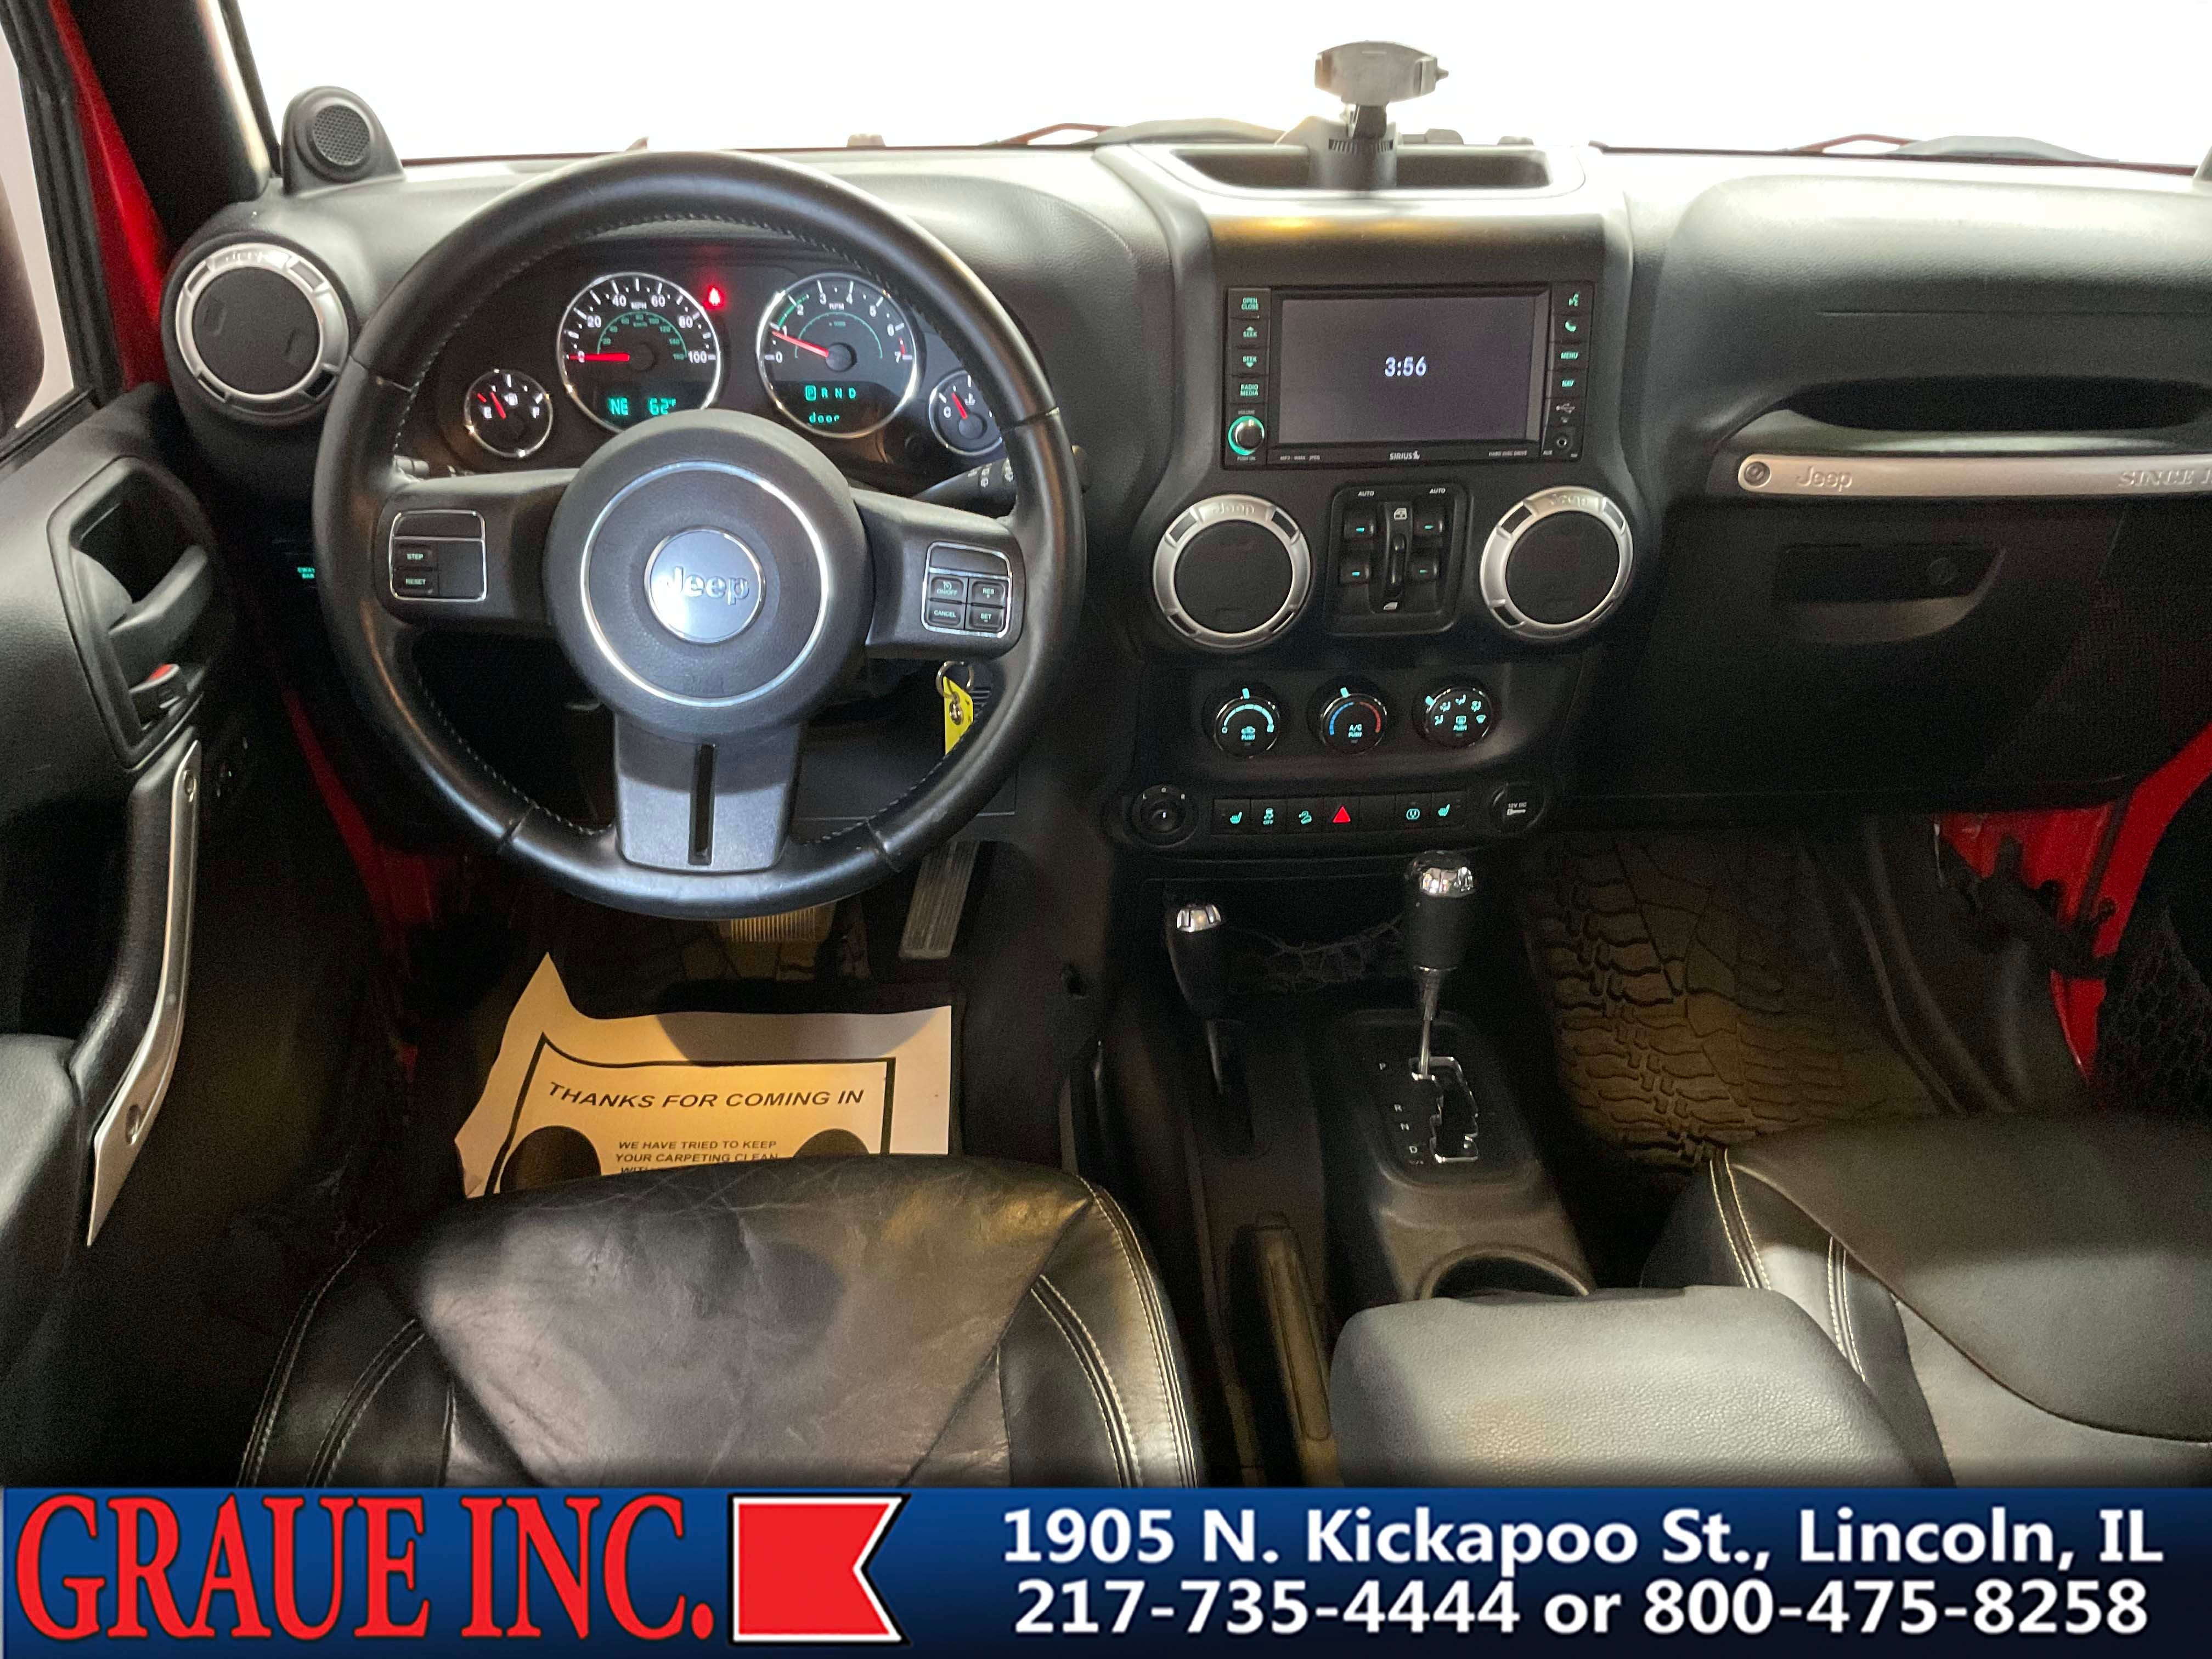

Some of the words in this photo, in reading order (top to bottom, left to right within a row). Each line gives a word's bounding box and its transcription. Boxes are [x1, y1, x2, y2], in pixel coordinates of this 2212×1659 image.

[612, 294, 627, 307] 40
[651, 294, 666, 307] 60
[819, 293, 827, 305] 3
[845, 293, 853, 305] 4
[630, 302, 647, 311] MPH
[1241, 303, 1259, 311] CLOSE
[586, 315, 602, 328] 20
[679, 315, 693, 329] 80
[687, 351, 708, 364] 100
[775, 351, 783, 364] 0
[894, 351, 902, 363] 7
[1560, 352, 1578, 360] MENU
[1384, 356, 1427, 377] 3:56
[821, 387, 829, 399] R
[834, 387, 843, 399] N
[848, 387, 857, 399] D
[610, 398, 629, 416] NE
[809, 412, 840, 424] door
[1389, 452, 1413, 460] SIRIUS
[1795, 465, 1853, 493] Jeep
[2118, 469, 2195, 487] SINCE
[664, 565, 751, 606] Jeep
[933, 610, 957, 618] CANCEL
[1348, 723, 1362, 731] A/C
[550, 1081, 656, 1108] THANKS
[662, 1093, 718, 1108] FOR
[725, 1091, 831, 1107] COMING
[837, 1089, 865, 1105] IN
[619, 1141, 640, 1150] WE
[642, 1141, 676, 1150] HAVE
[681, 1141, 719, 1150] TRIED
[722, 1140, 739, 1149] TO
[742, 1140, 777, 1149] KEEP
[1408, 1145, 1418, 1154] D
[615, 1153, 652, 1163] YOUR
[656, 1153, 731, 1163] CARPETING
